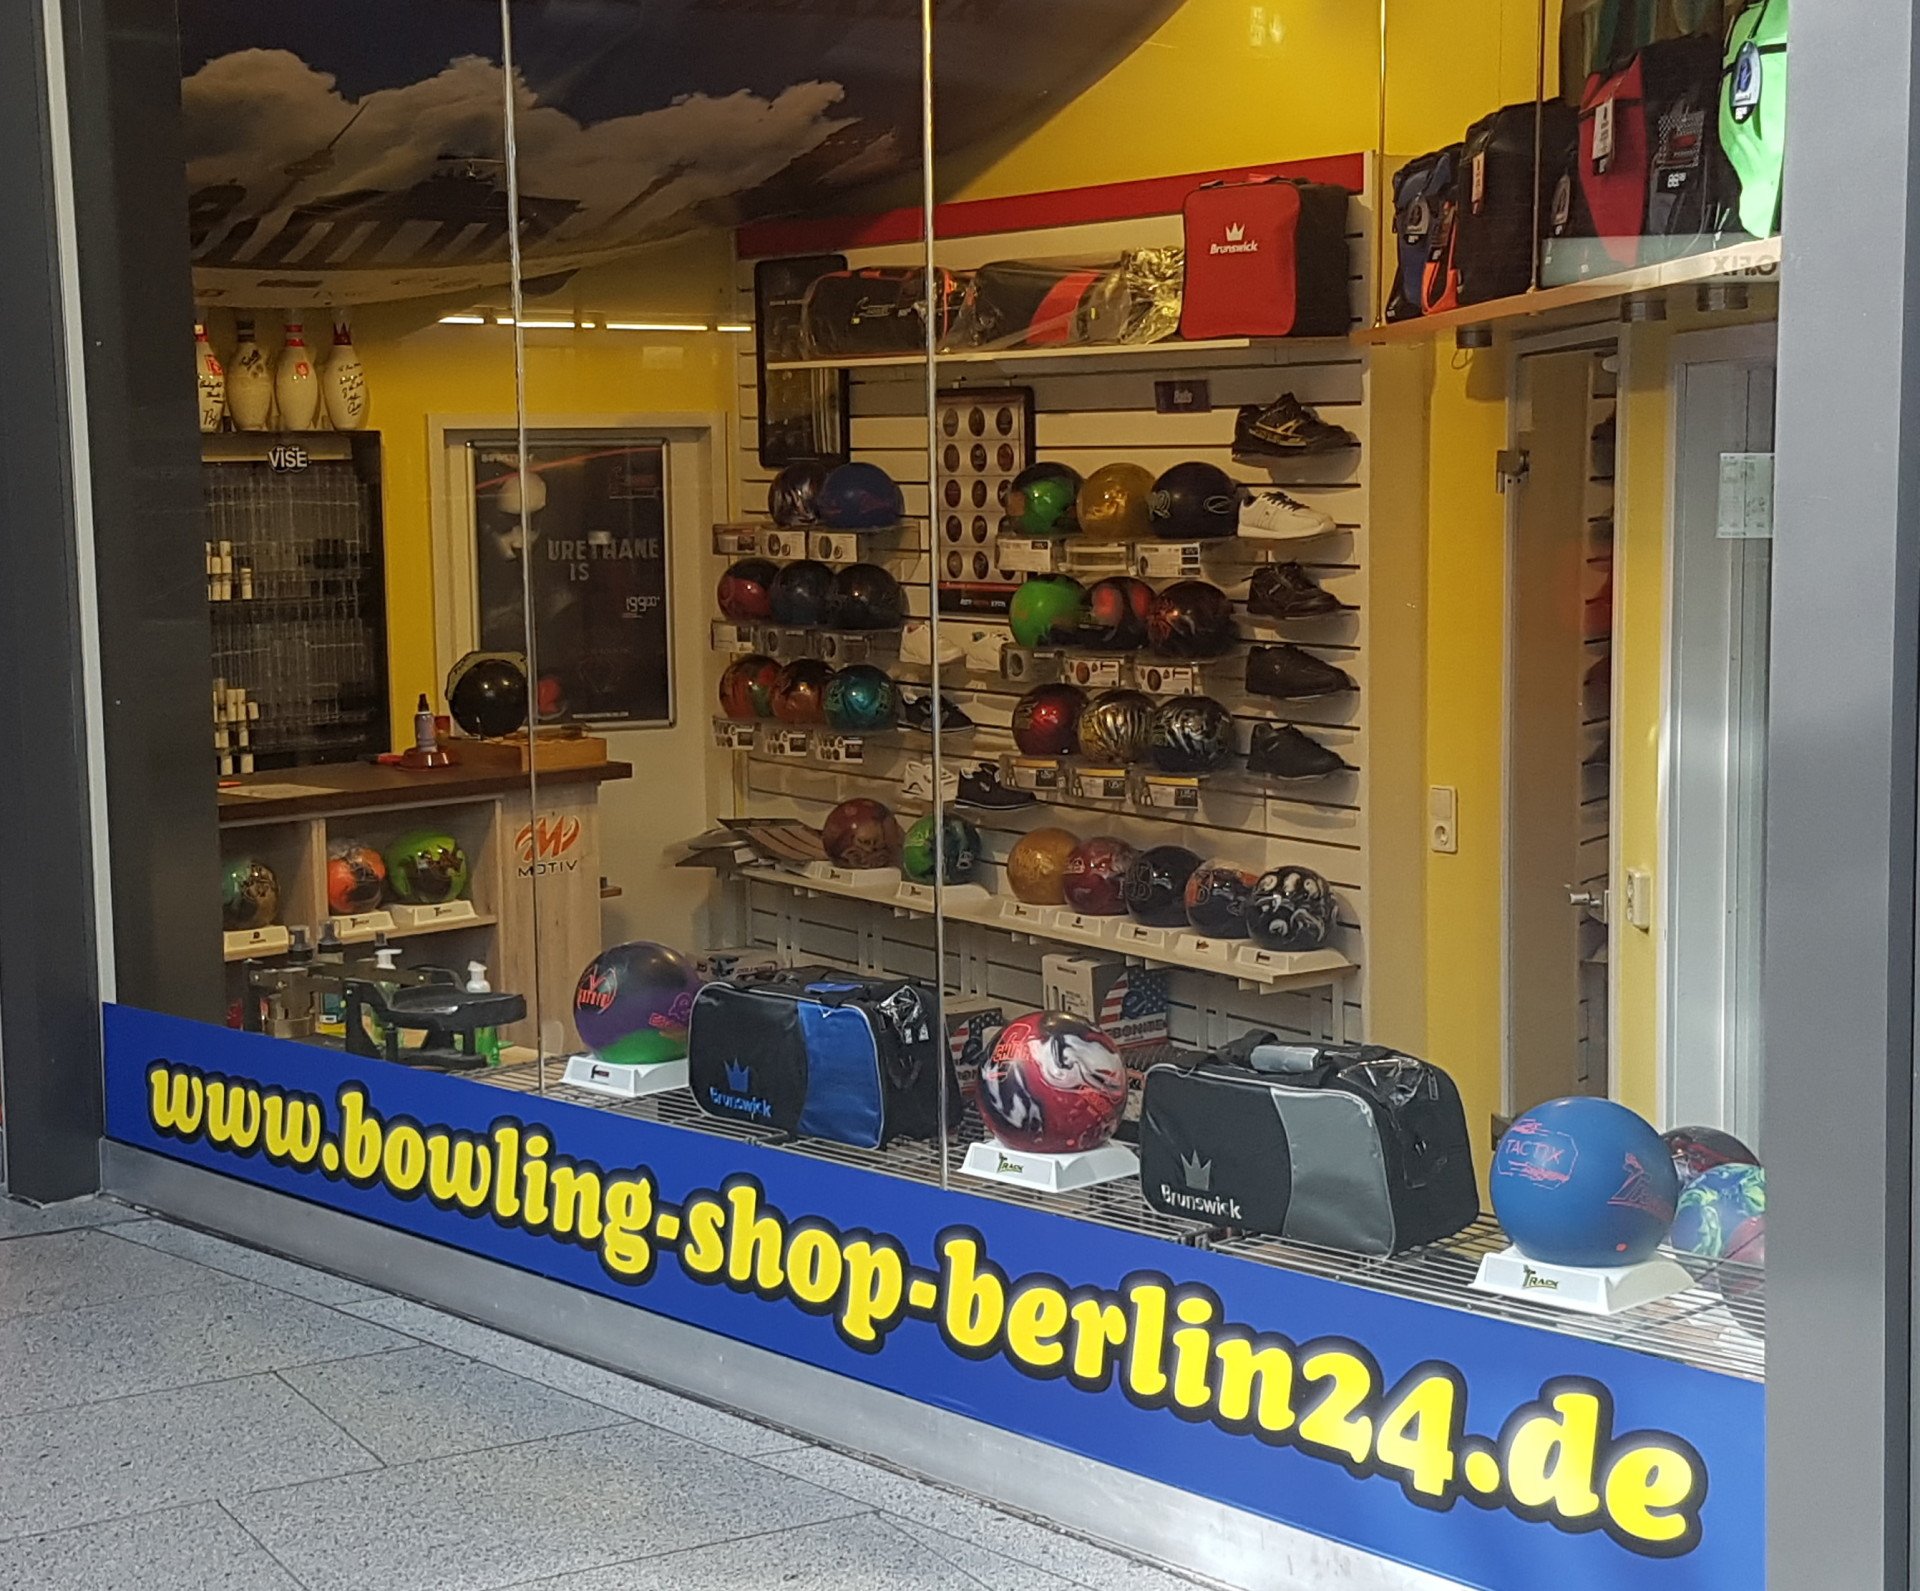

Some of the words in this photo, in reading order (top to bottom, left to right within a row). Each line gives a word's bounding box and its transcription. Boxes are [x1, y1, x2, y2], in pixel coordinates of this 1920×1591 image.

[1210, 240, 1258, 255] Brunswick
[268, 450, 307, 468] VISE
[547, 538, 659, 561] URETHANE
[518, 860, 578, 877] MOTIV
[710, 1087, 772, 1118] Brunswick
[1160, 1184, 1242, 1220] Brunswick
[150, 1067, 1700, 1547] www.bowling-shop-berlin24.de
